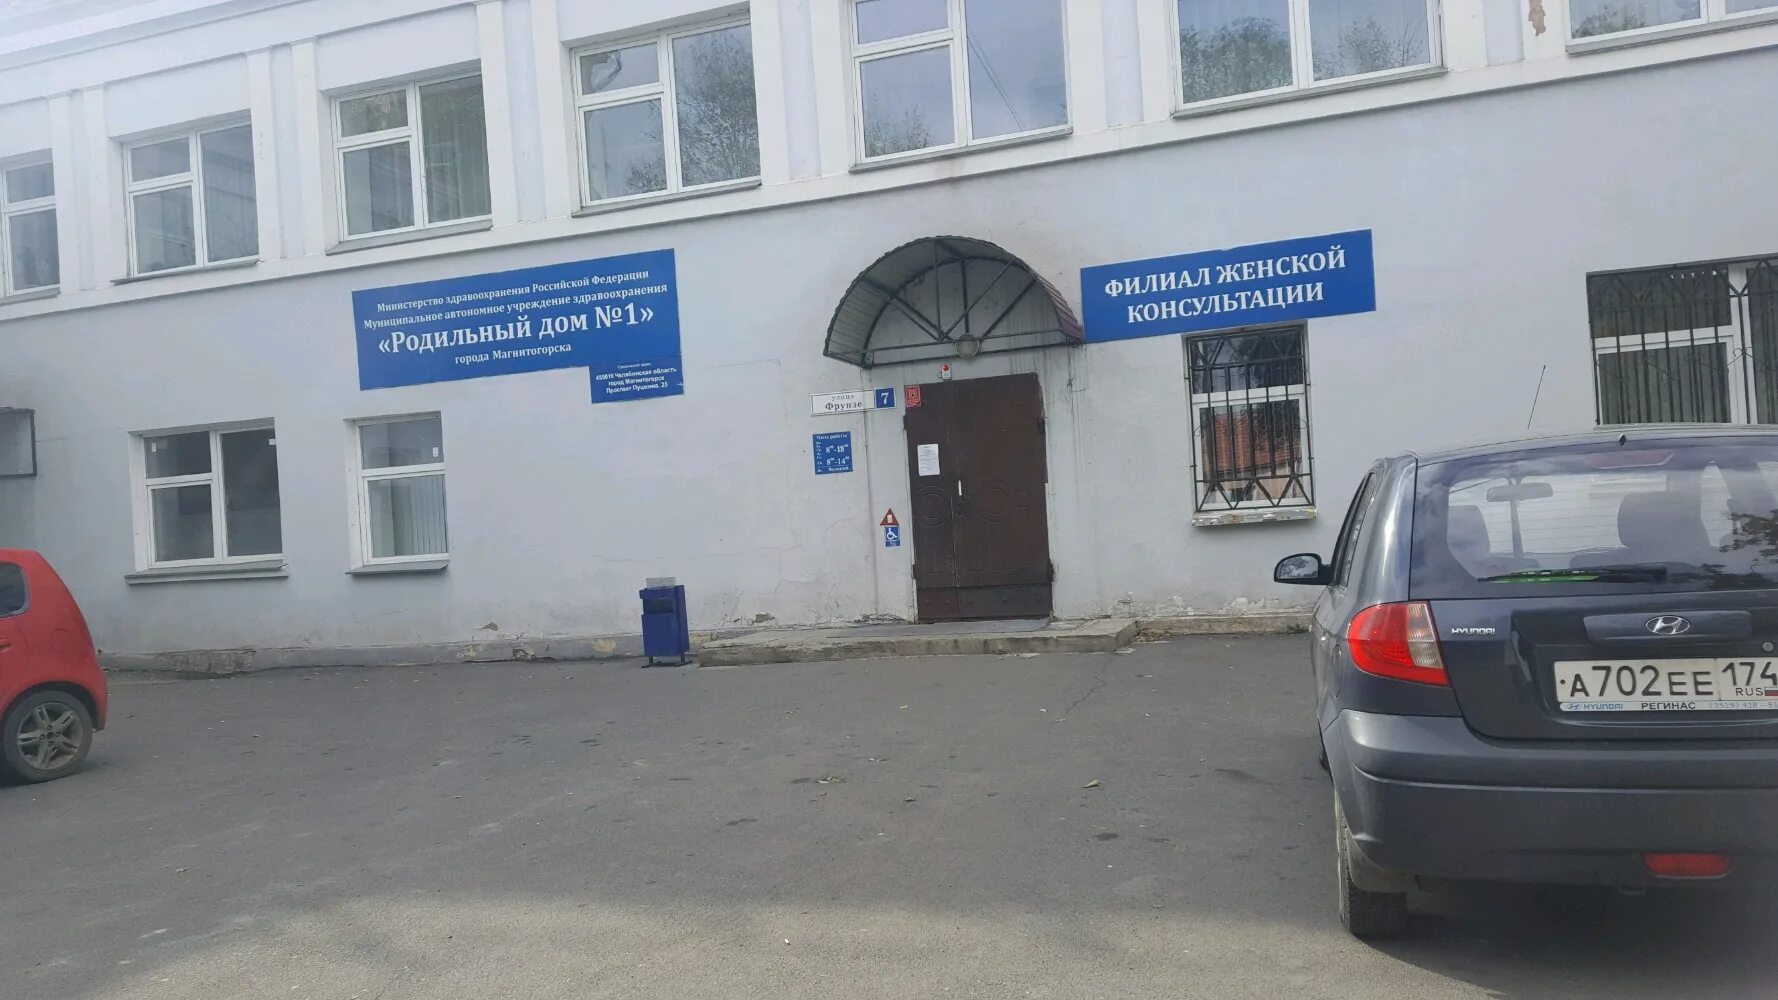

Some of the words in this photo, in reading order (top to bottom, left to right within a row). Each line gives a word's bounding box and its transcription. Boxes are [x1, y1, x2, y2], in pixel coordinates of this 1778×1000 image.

[1104, 267, 1211, 297] ФИЛИАЛ
[1216, 244, 1347, 284] ЖЕНСКОЙ
[377, 296, 444, 313] Министерство
[445, 285, 531, 305] здравоохранения
[532, 276, 590, 293] Российской
[591, 269, 649, 286] Федерации
[363, 311, 443, 330] Муниципальное
[444, 304, 505, 320] автономное
[506, 296, 571, 315] учреждение
[573, 284, 668, 306] здравоохранения
[1127, 282, 1324, 324] КОНСУЛЬТАЦИИ
[378, 315, 532, 355] «Родильный
[539, 313, 588, 340] дом
[595, 301, 654, 330] №1»
[454, 352, 489, 366] города
[492, 342, 572, 361] Магнитогорска
[608, 379, 624, 387] город
[825, 401, 863, 412] Фрунзе
[831, 394, 855, 402] улица
[880, 392, 889, 405] 7
[1451, 628, 1496, 636] HYUNDAI
[1569, 664, 1714, 697] А702ЕЕ
[1721, 661, 1777, 686] 174
[1735, 687, 1764, 696] RUS
[1641, 701, 1696, 710] РЕГИНАС
